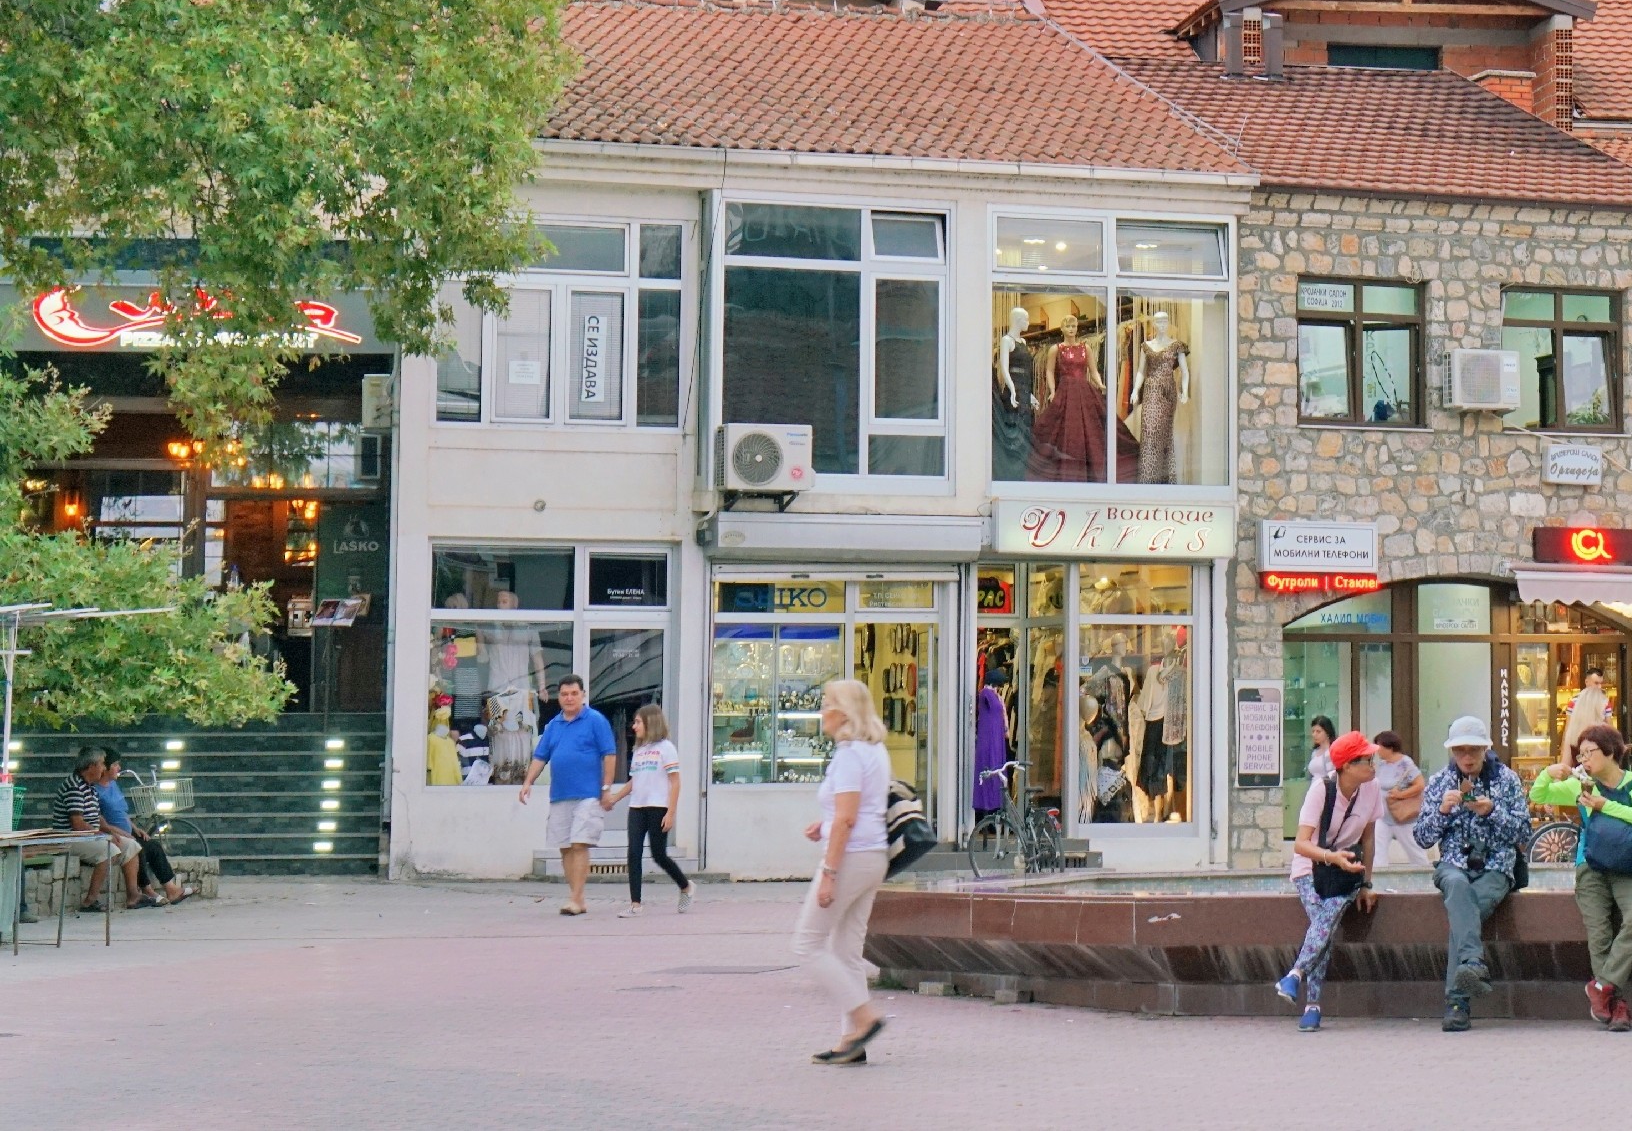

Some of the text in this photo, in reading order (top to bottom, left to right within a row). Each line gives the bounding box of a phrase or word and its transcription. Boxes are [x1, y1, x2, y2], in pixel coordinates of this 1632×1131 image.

[583, 315, 599, 400] СЕ ИЗДАВА
[1107, 507, 1214, 525] Boutique
[1296, 535, 1346, 544] СЕРВИС ЗА
[1274, 549, 1369, 559] МОБИЛНИ ТЕЛЕФОНИ
[1267, 574, 1318, 590] Футроли
[1270, 704, 1278, 712] ЗА
[1500, 669, 1509, 747] HANDMADE
[1241, 723, 1279, 731] ТЕЛЕФОНИ
[1244, 762, 1276, 770] SERVICE
